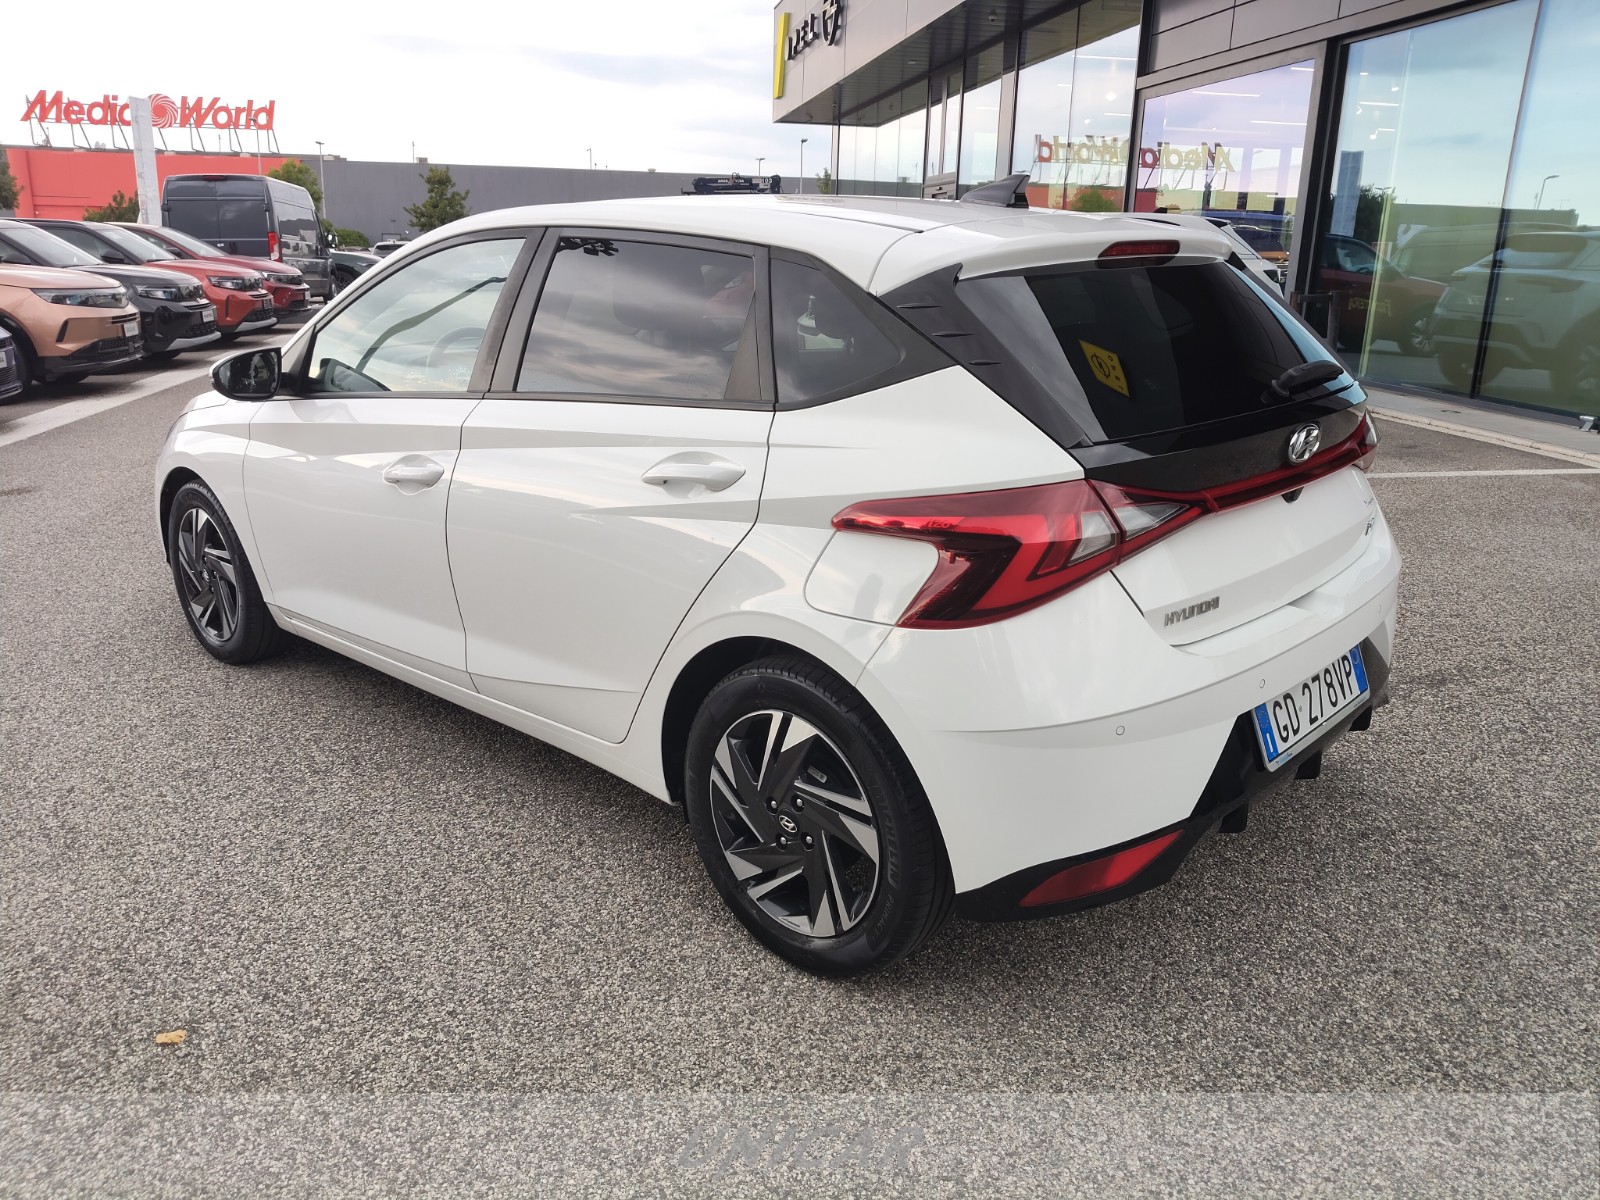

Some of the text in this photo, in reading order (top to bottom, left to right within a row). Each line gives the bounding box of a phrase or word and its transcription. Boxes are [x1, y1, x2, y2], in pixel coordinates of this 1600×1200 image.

[180, 96, 275, 130] World
[1164, 596, 1219, 627] HYUNDAI
[1273, 655, 1353, 743] GD 278VP
